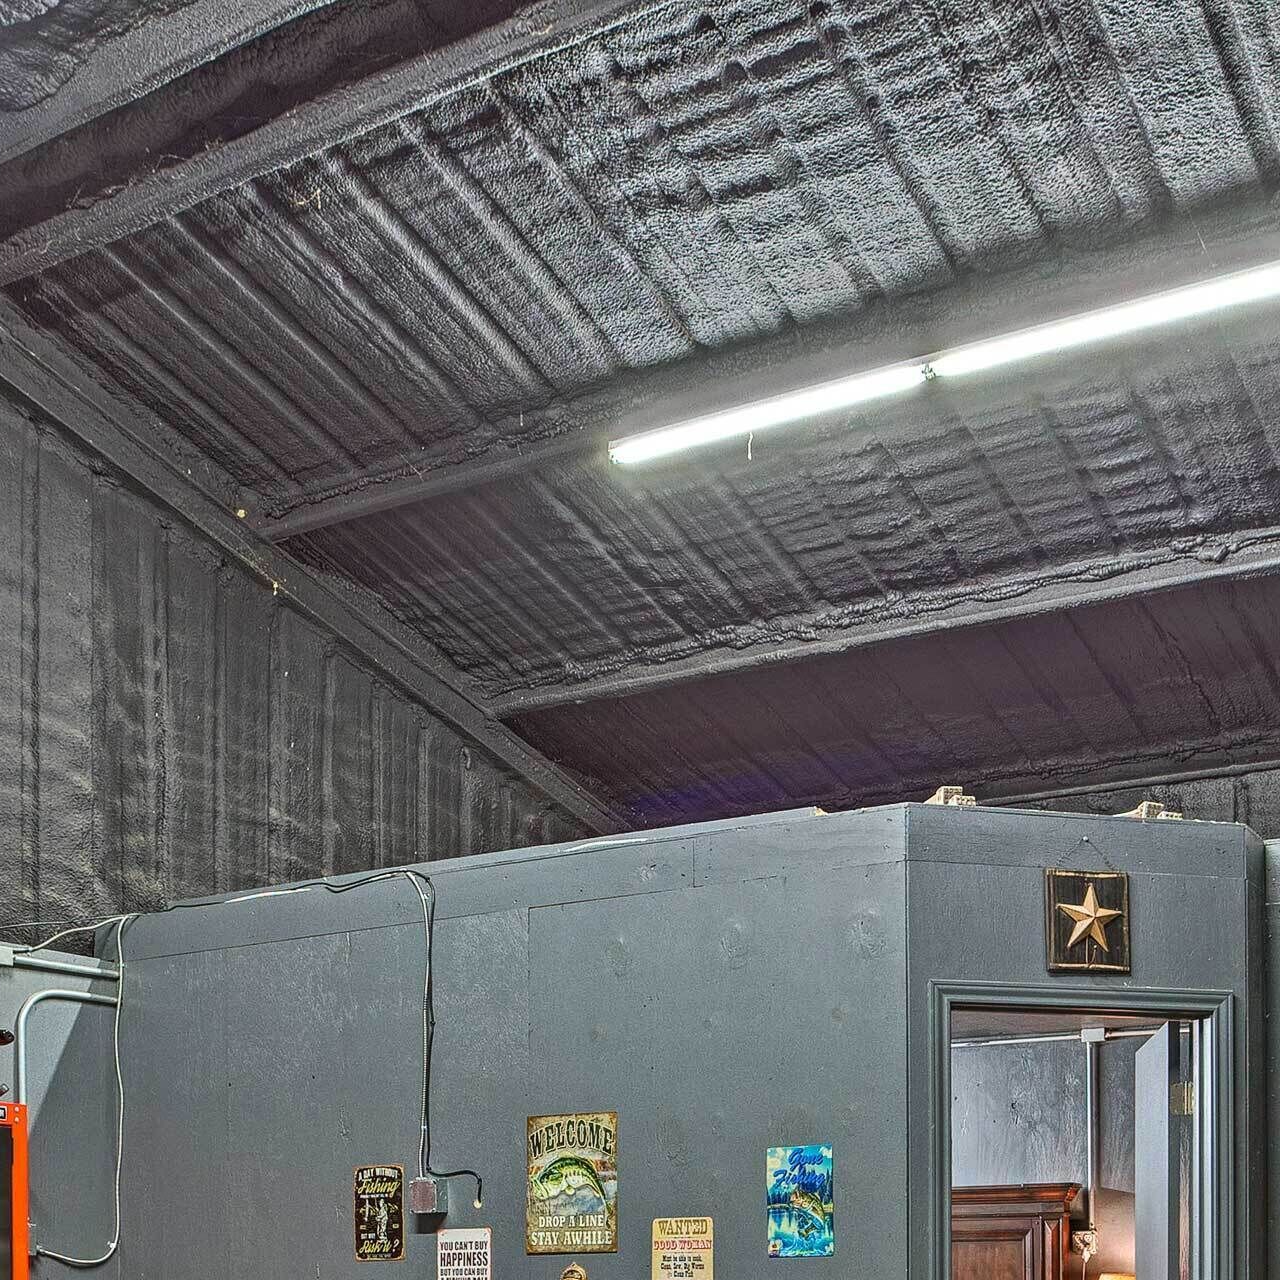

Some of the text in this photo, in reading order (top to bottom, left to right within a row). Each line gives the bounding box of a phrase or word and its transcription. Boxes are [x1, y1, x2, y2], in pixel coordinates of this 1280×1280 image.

[529, 1119, 613, 1159] WELCOME
[788, 1148, 824, 1171] Gone
[358, 1177, 400, 1198] Fishing
[538, 1215, 604, 1228] DROP A LINE
[658, 1219, 708, 1236] WANTED
[531, 1230, 613, 1246] STAY AWHILE
[654, 1240, 712, 1251] GOOD WOMAN
[440, 1241, 488, 1251] YOU CAN'T BUY
[440, 1252, 488, 1267] HAPPINESS
[440, 1268, 488, 1276] BUT YOU CAN BUY
